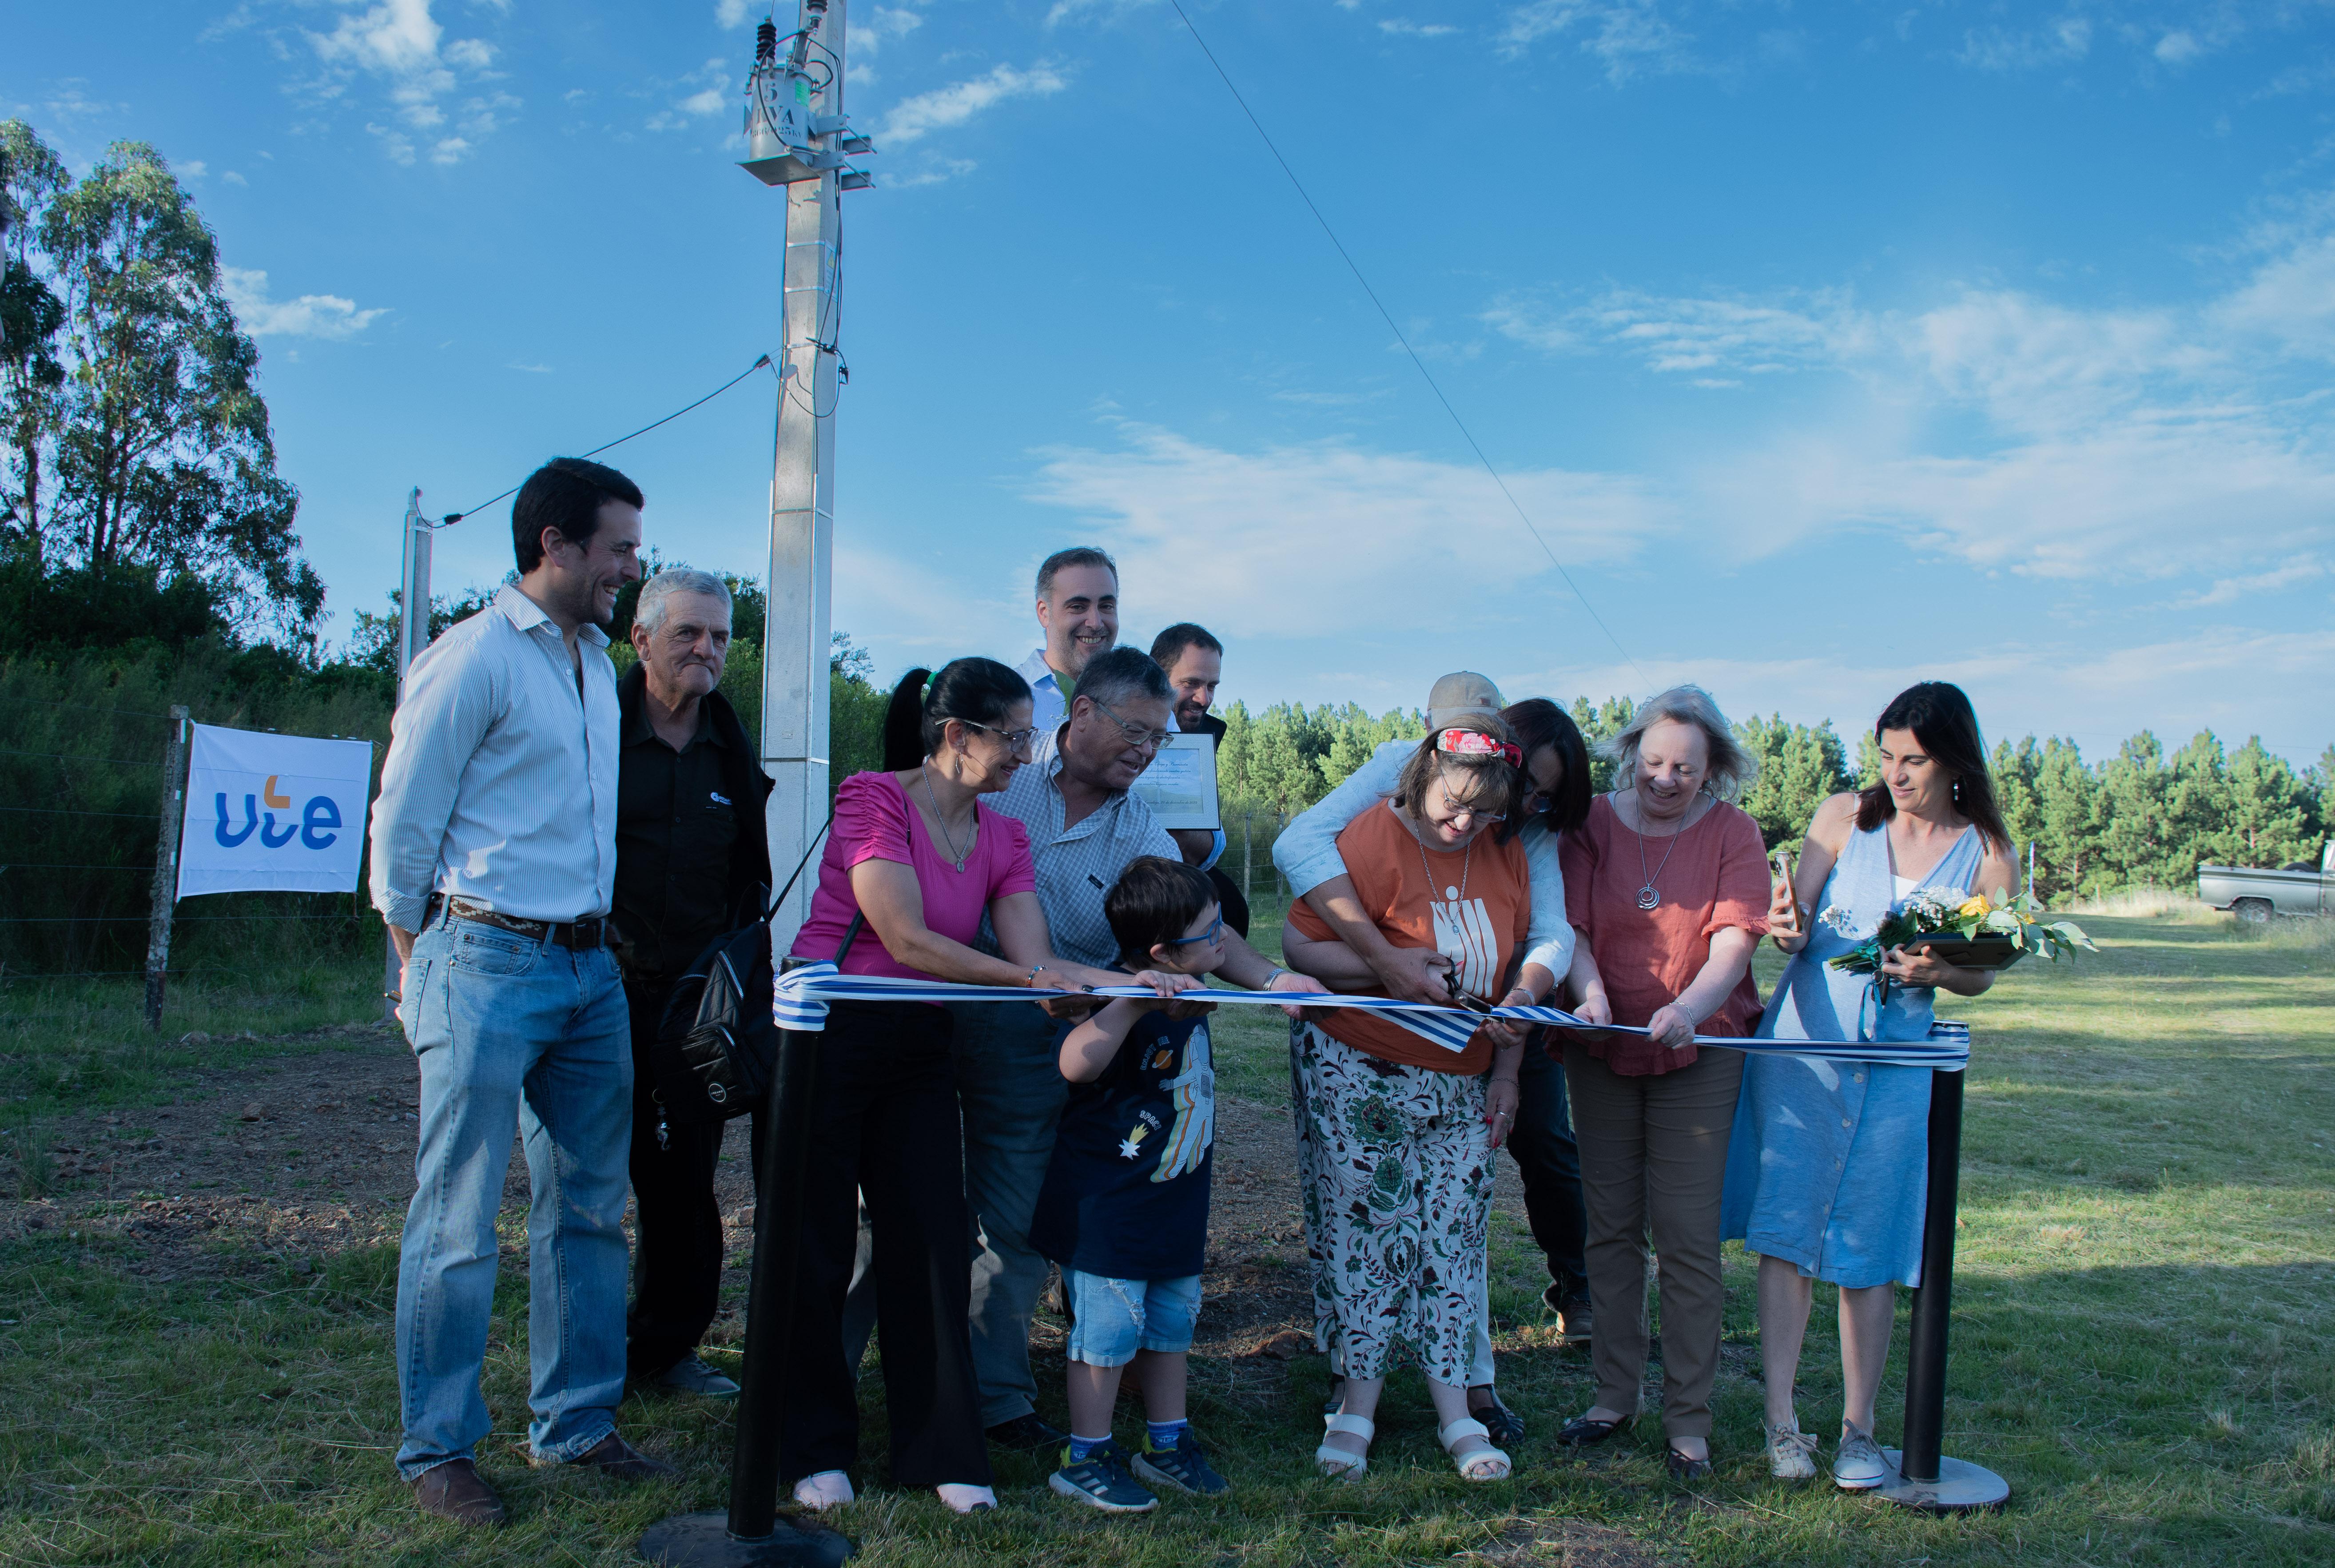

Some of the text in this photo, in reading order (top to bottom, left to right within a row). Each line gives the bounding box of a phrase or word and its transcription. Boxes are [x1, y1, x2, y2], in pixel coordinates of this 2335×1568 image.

[764, 82, 778, 102] 5
[1140, 1036, 1170, 1070] ENJOY THE
[1139, 1110, 1162, 1131] SPACE
